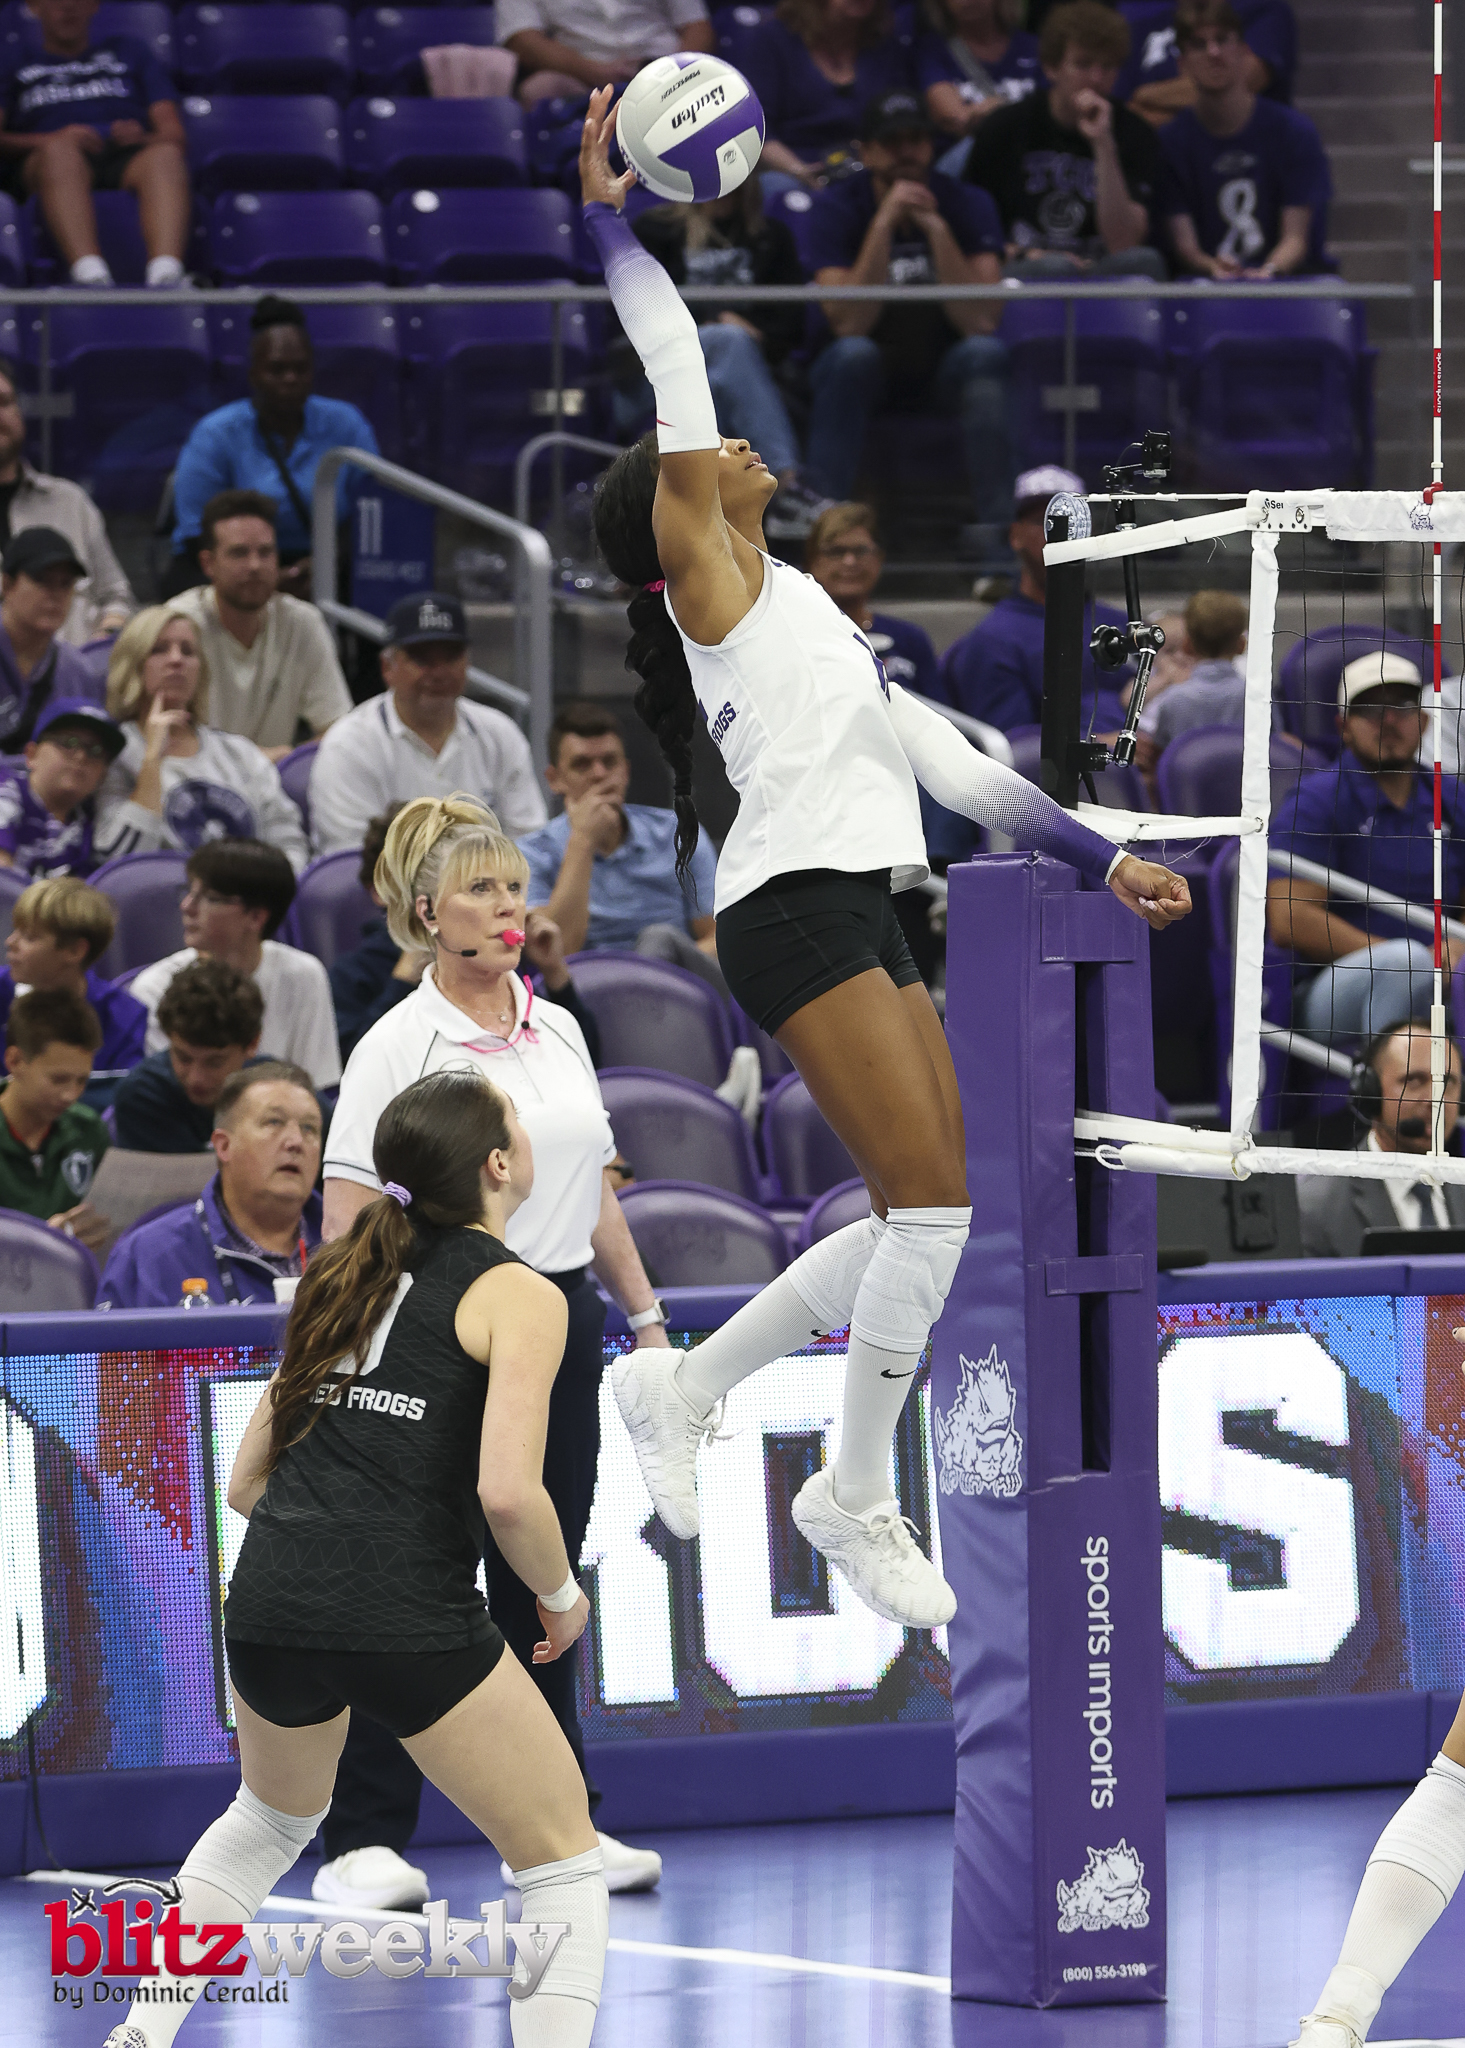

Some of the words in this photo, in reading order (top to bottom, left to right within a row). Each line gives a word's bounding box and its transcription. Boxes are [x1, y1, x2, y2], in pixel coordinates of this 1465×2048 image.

[671, 84, 726, 130] Baden
[711, 701, 737, 748] ROGS
[347, 1386, 427, 1421] FROGS
[1080, 1536, 1114, 1656] sports
[1083, 1662, 1118, 1810] imports
[1062, 1966, 1093, 1984] (800)
[1094, 1962, 1148, 1980] 556-3198
